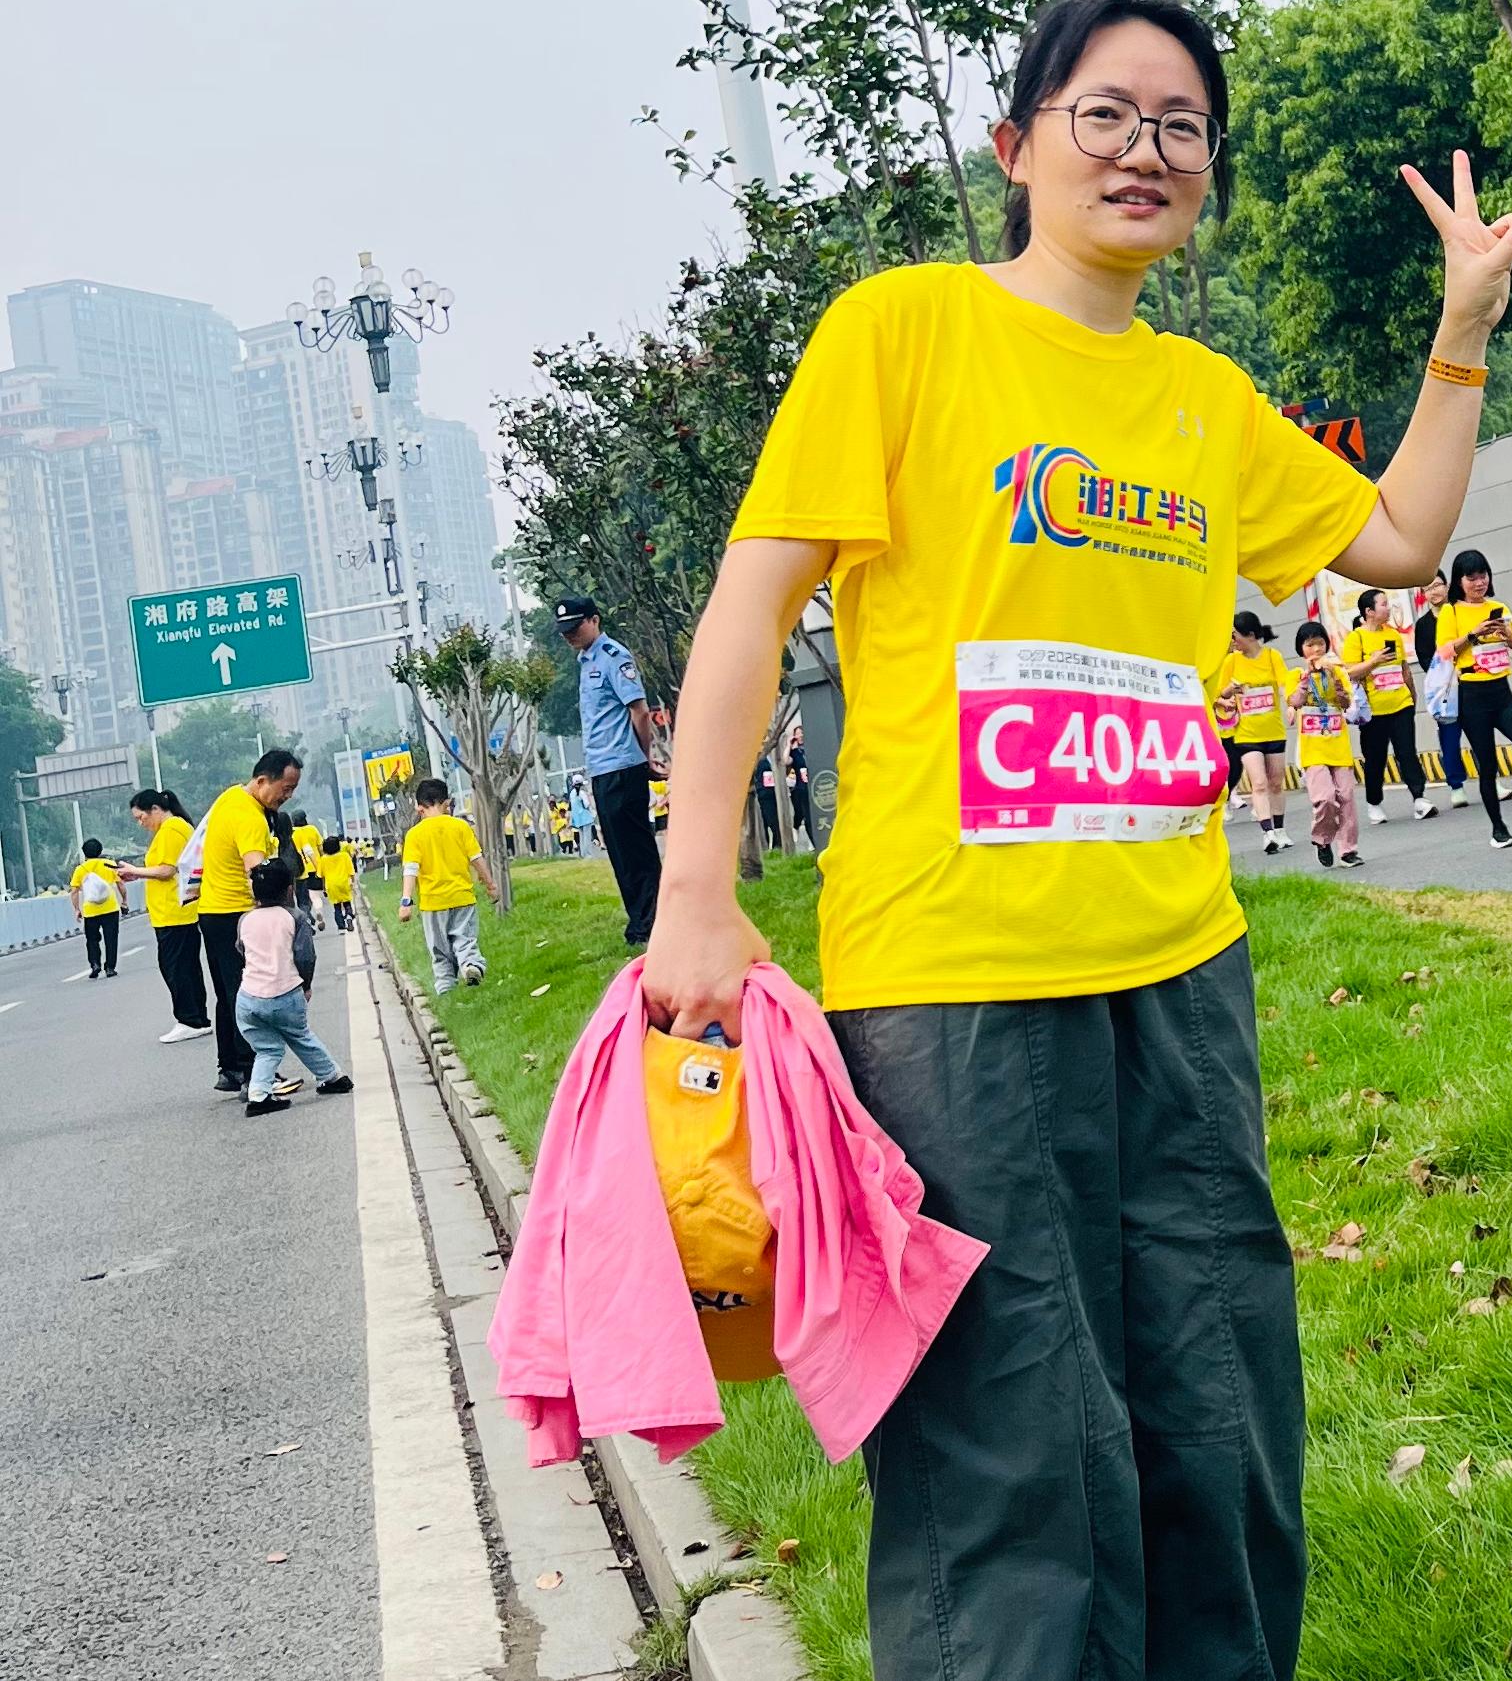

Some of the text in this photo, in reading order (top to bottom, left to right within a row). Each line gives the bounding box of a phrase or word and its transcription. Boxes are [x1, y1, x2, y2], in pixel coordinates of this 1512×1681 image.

[1077, 472, 1207, 543] 湘江半马
[144, 587, 289, 627] 湘府路高架
[156, 614, 287, 643] Xiangfu Elevated Rd.
